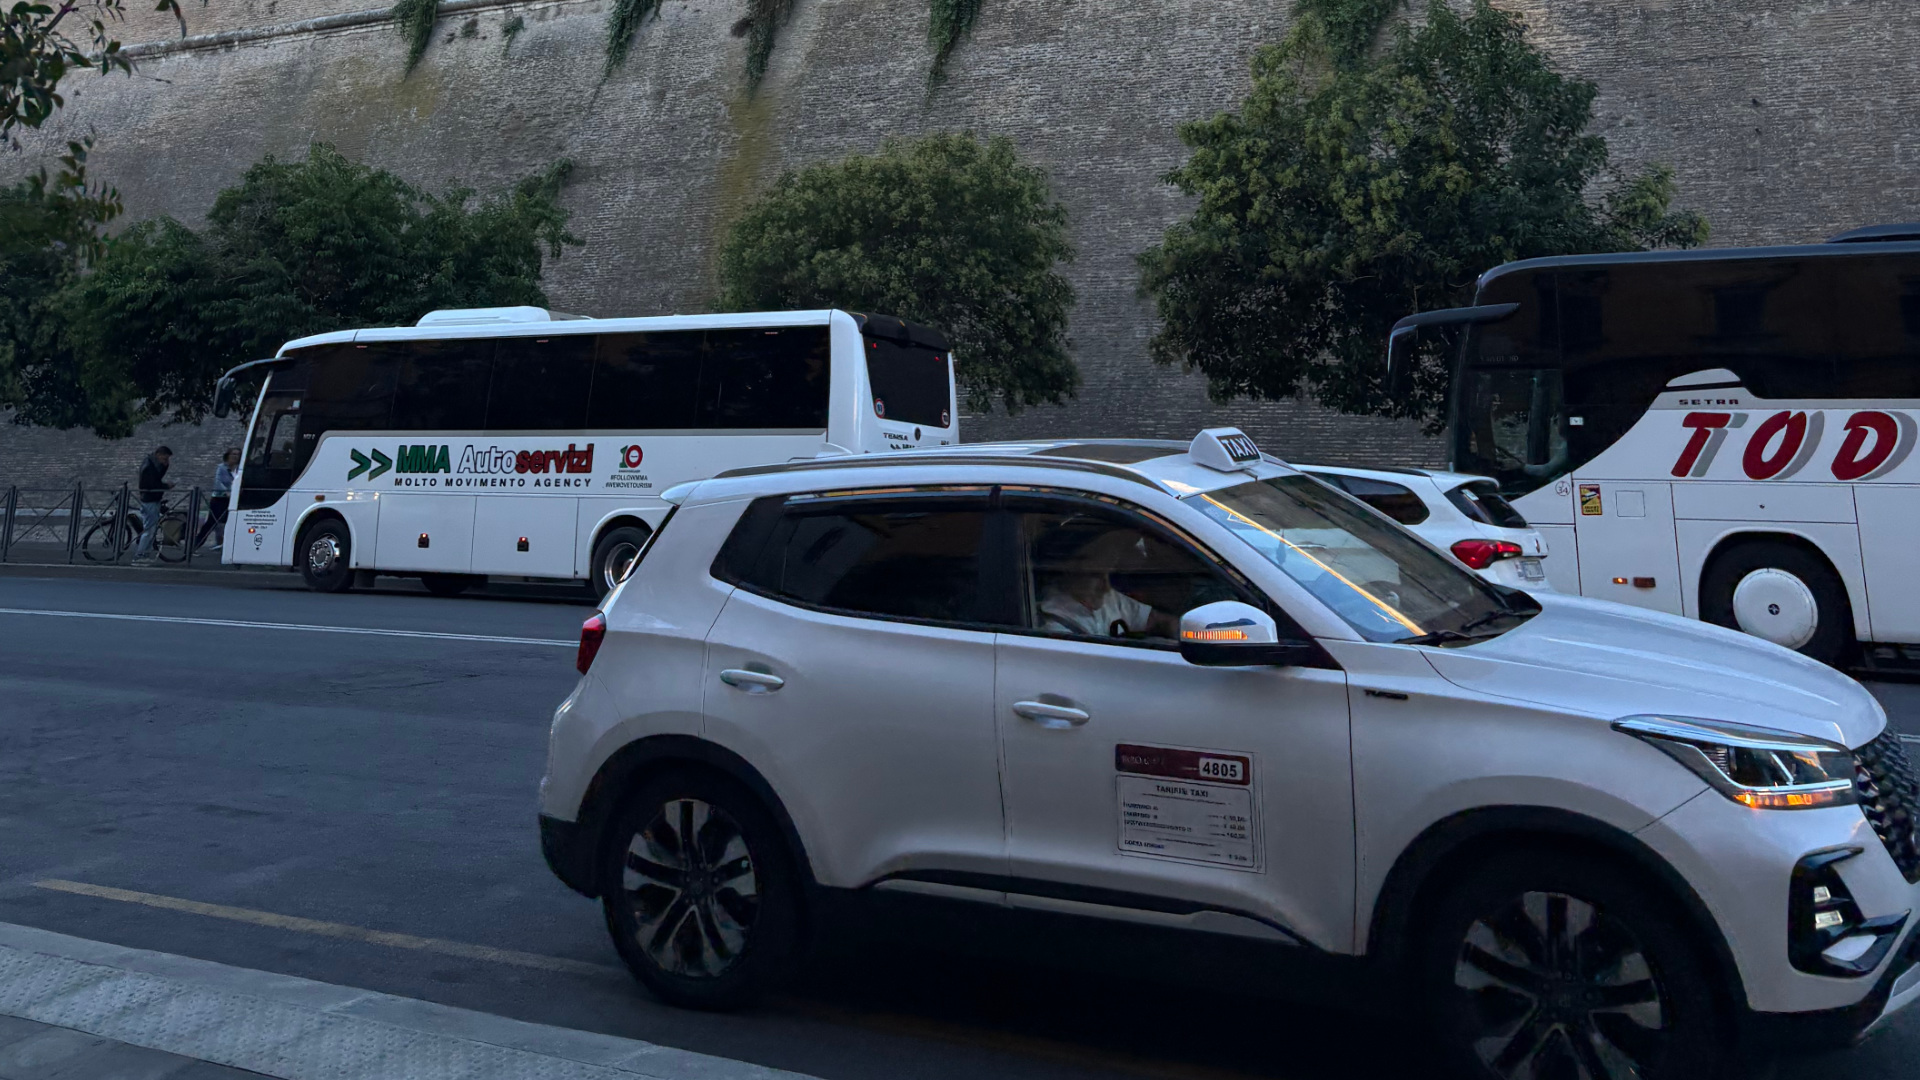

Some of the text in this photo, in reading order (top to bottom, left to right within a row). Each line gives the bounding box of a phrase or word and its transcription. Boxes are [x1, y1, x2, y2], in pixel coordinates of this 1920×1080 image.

[618, 444, 644, 469] 10
[1220, 437, 1257, 458] TAXI
[395, 443, 595, 474] MMA Autoservizi
[394, 477, 592, 488] MOLTO MOVIMENTO AGENCY
[1202, 761, 1238, 778] 4805
[1190, 788, 1209, 798] TAXI
